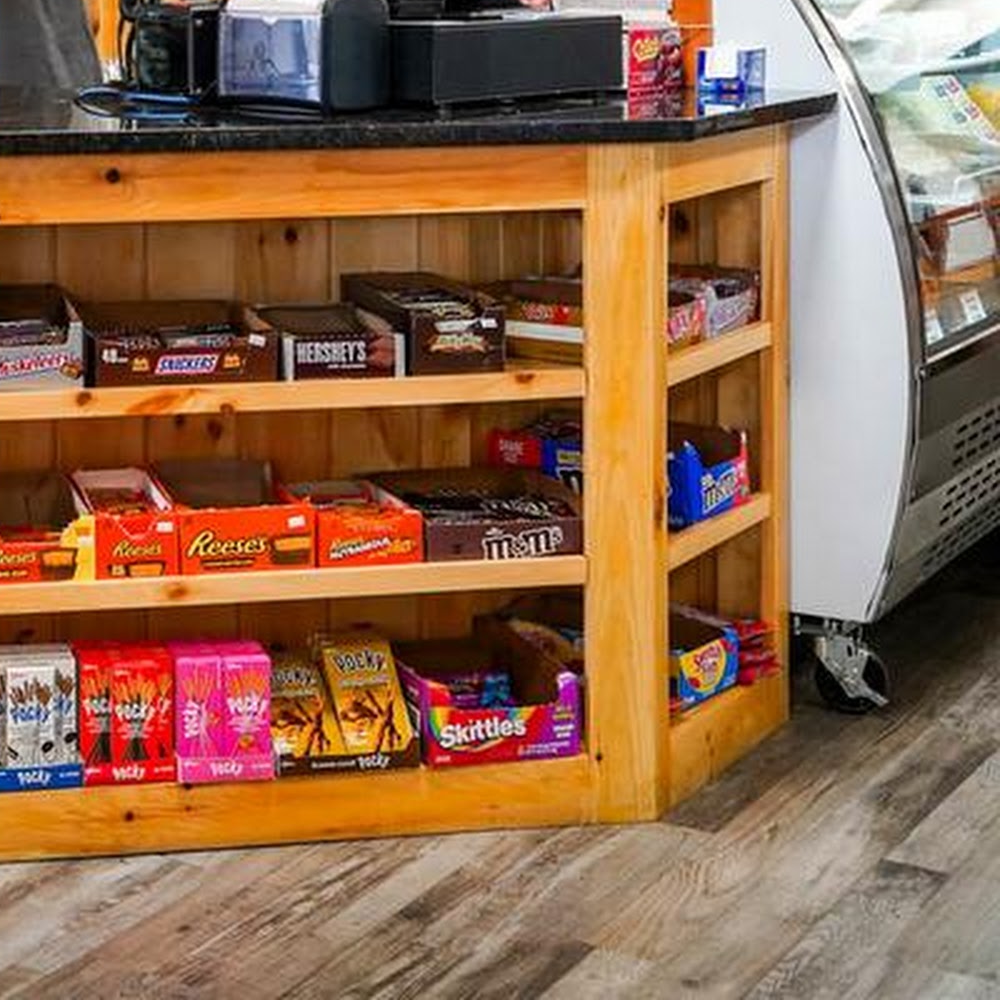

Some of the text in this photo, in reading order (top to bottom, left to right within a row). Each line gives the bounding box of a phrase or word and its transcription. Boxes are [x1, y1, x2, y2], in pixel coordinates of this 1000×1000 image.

[159, 355, 216, 372] SNICKERS
[297, 341, 366, 364] HERSHEY'S
[439, 715, 528, 750] Skittles
